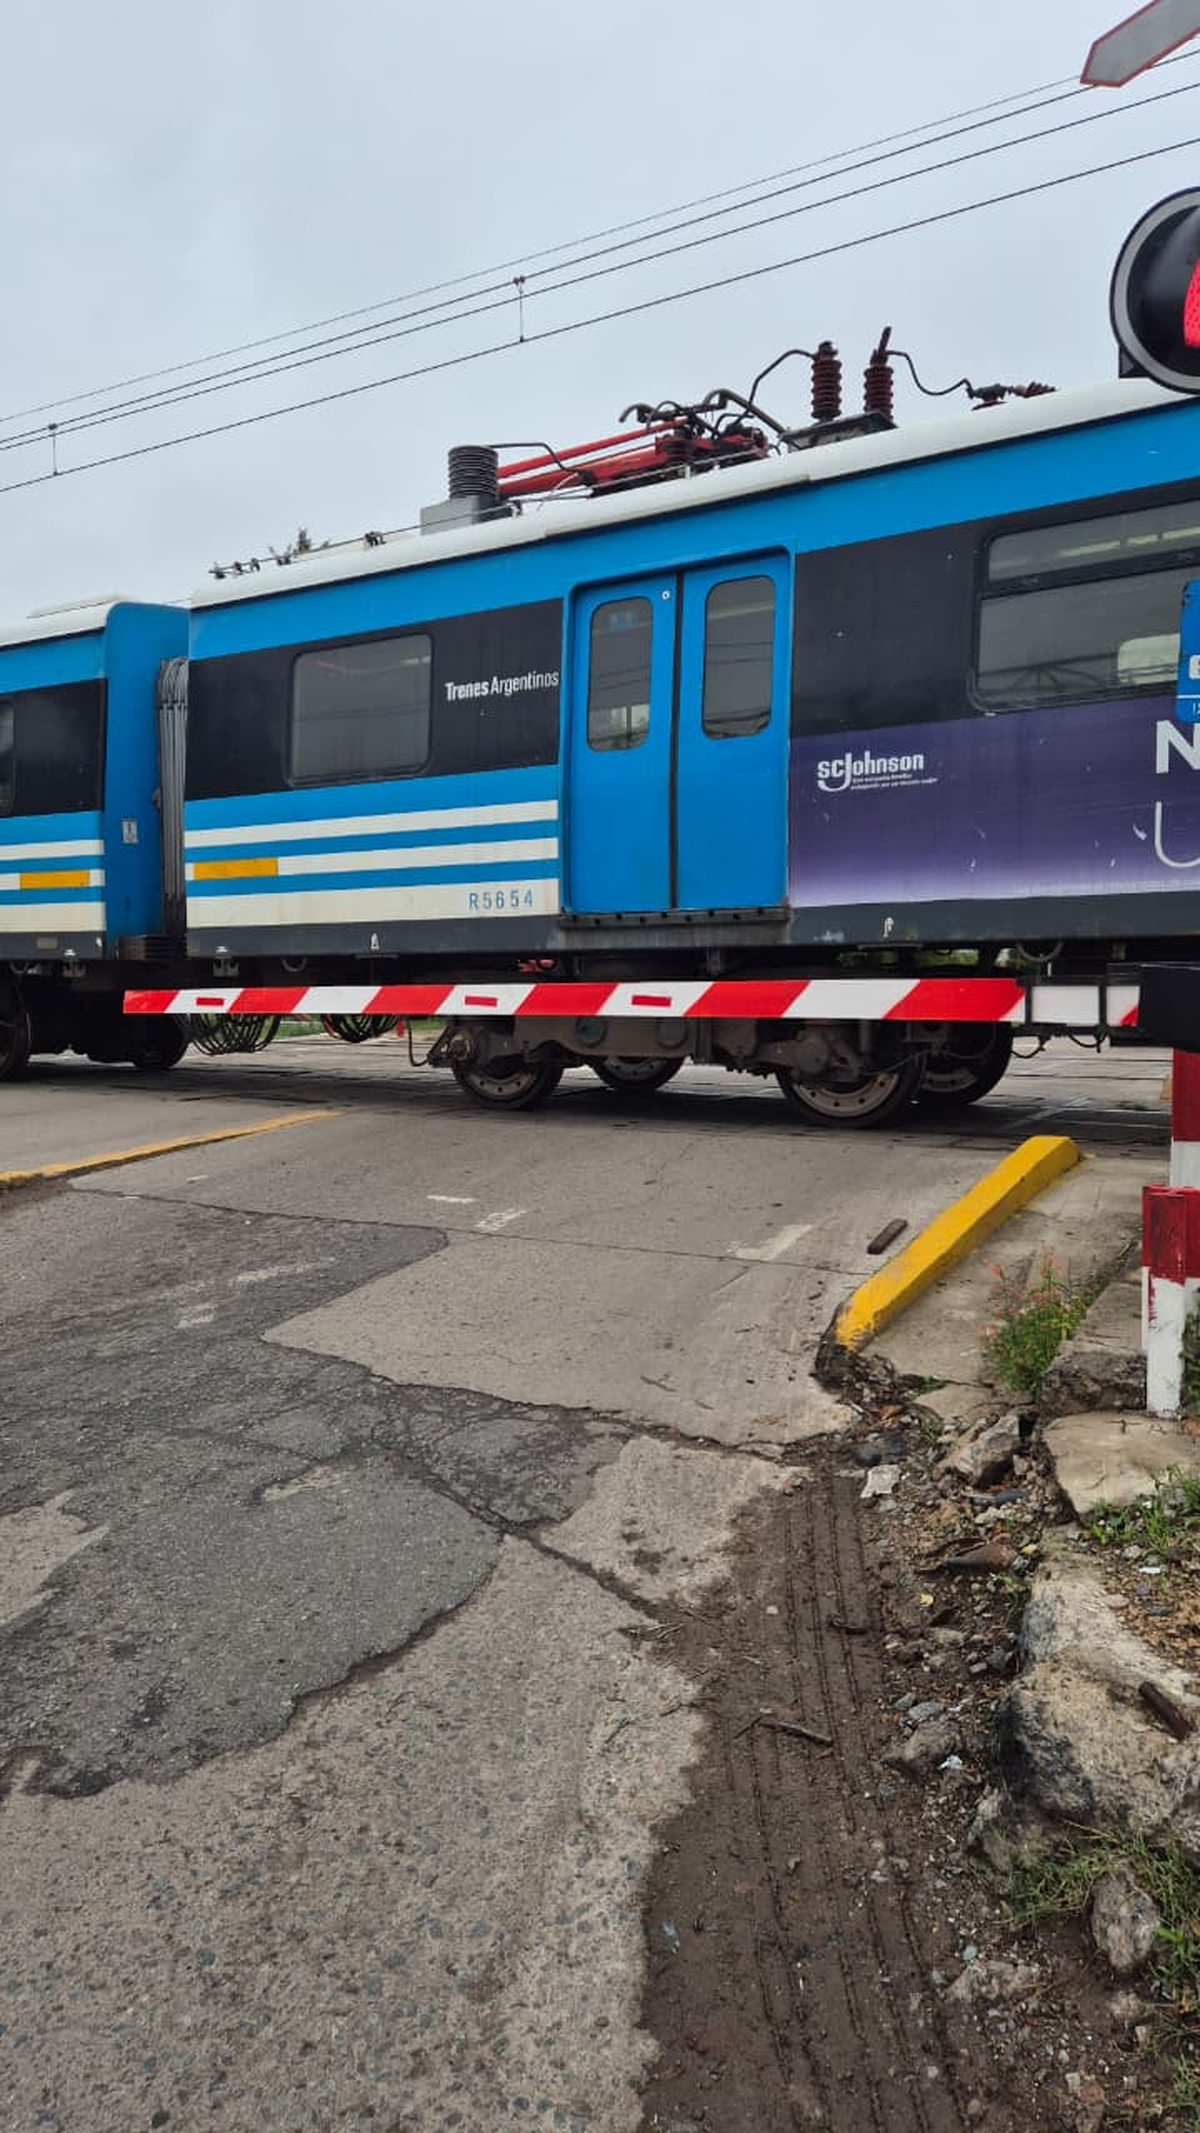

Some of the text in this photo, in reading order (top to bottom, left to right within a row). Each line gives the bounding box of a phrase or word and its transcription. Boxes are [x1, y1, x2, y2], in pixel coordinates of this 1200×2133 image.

[445, 670, 559, 701] Trenes Argentinos
[469, 889, 533, 909] R5654
